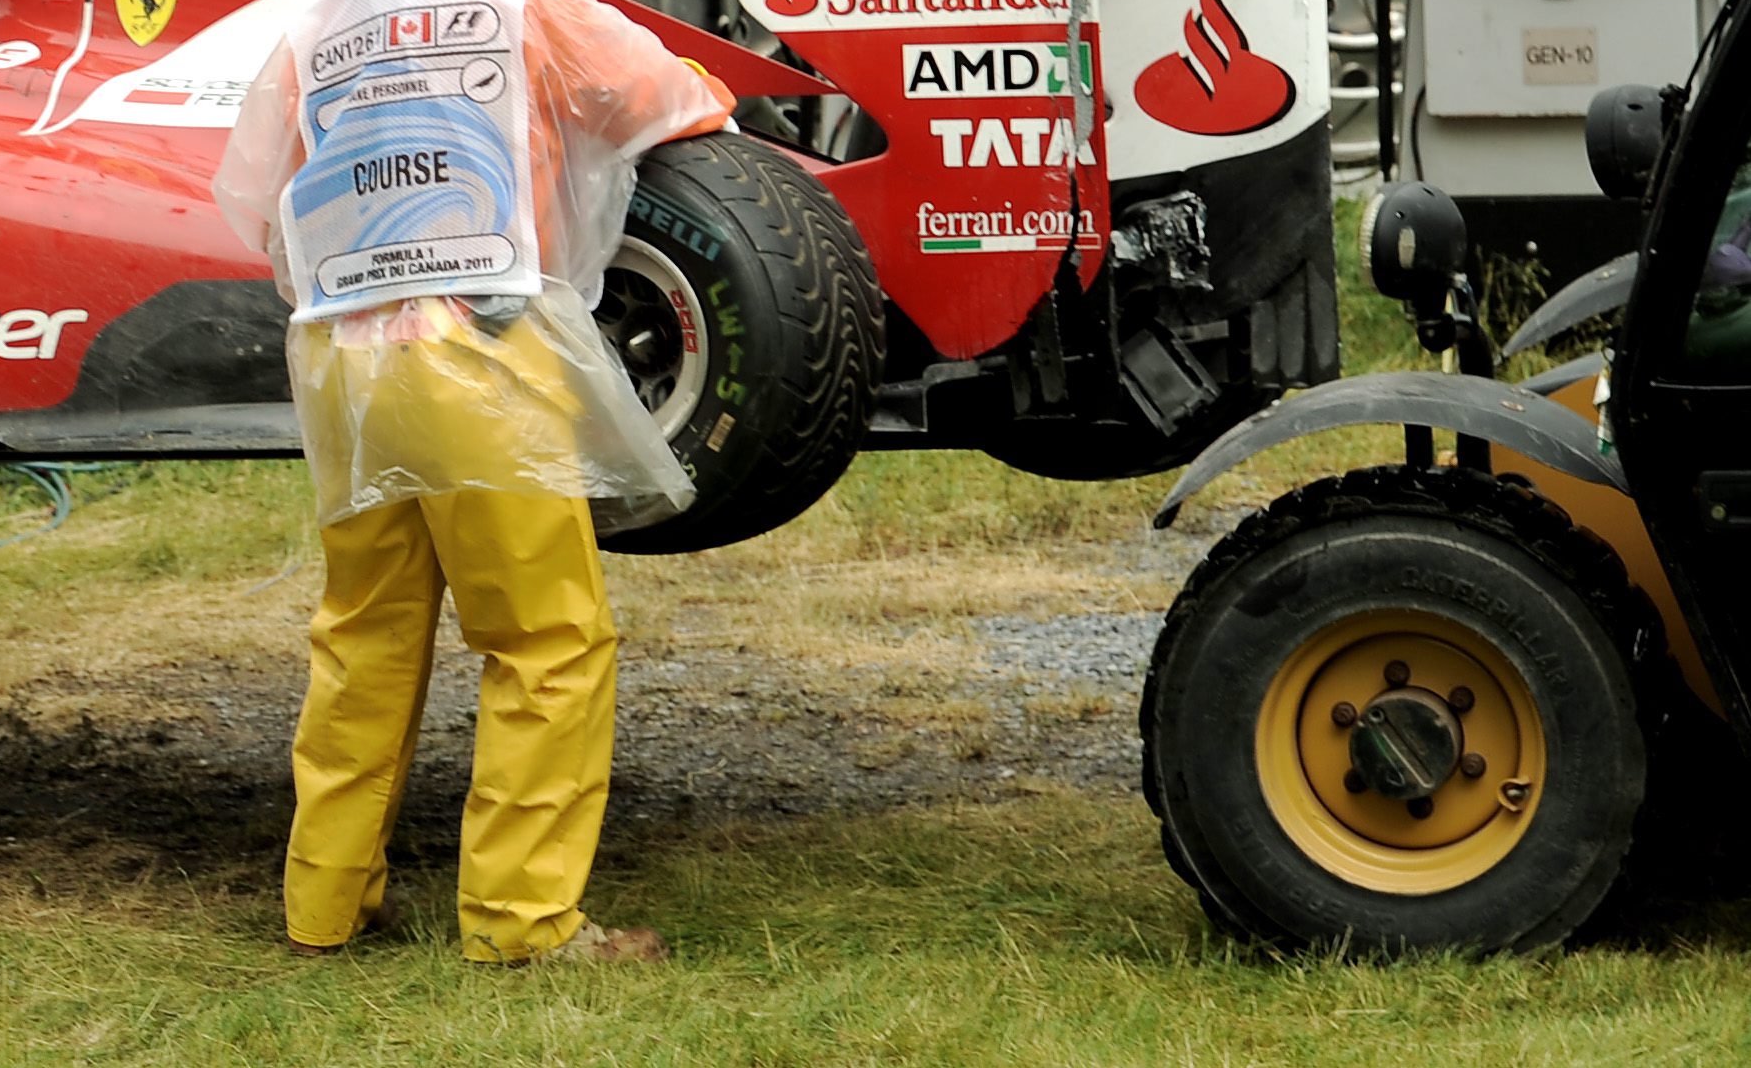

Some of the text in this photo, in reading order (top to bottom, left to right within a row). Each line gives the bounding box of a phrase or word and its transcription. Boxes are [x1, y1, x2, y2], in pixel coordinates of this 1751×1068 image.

[908, 49, 1040, 93] AMD
[1525, 47, 1594, 64] GEN-10
[930, 118, 1097, 167] TATA
[353, 150, 450, 197] COURSE
[628, 187, 726, 262] RELLI
[916, 201, 1096, 236] ferrari.com
[371, 248, 424, 266] FORMULA
[390, 265, 405, 277] DU
[408, 259, 461, 275] CANADA
[464, 257, 493, 270] 2011
